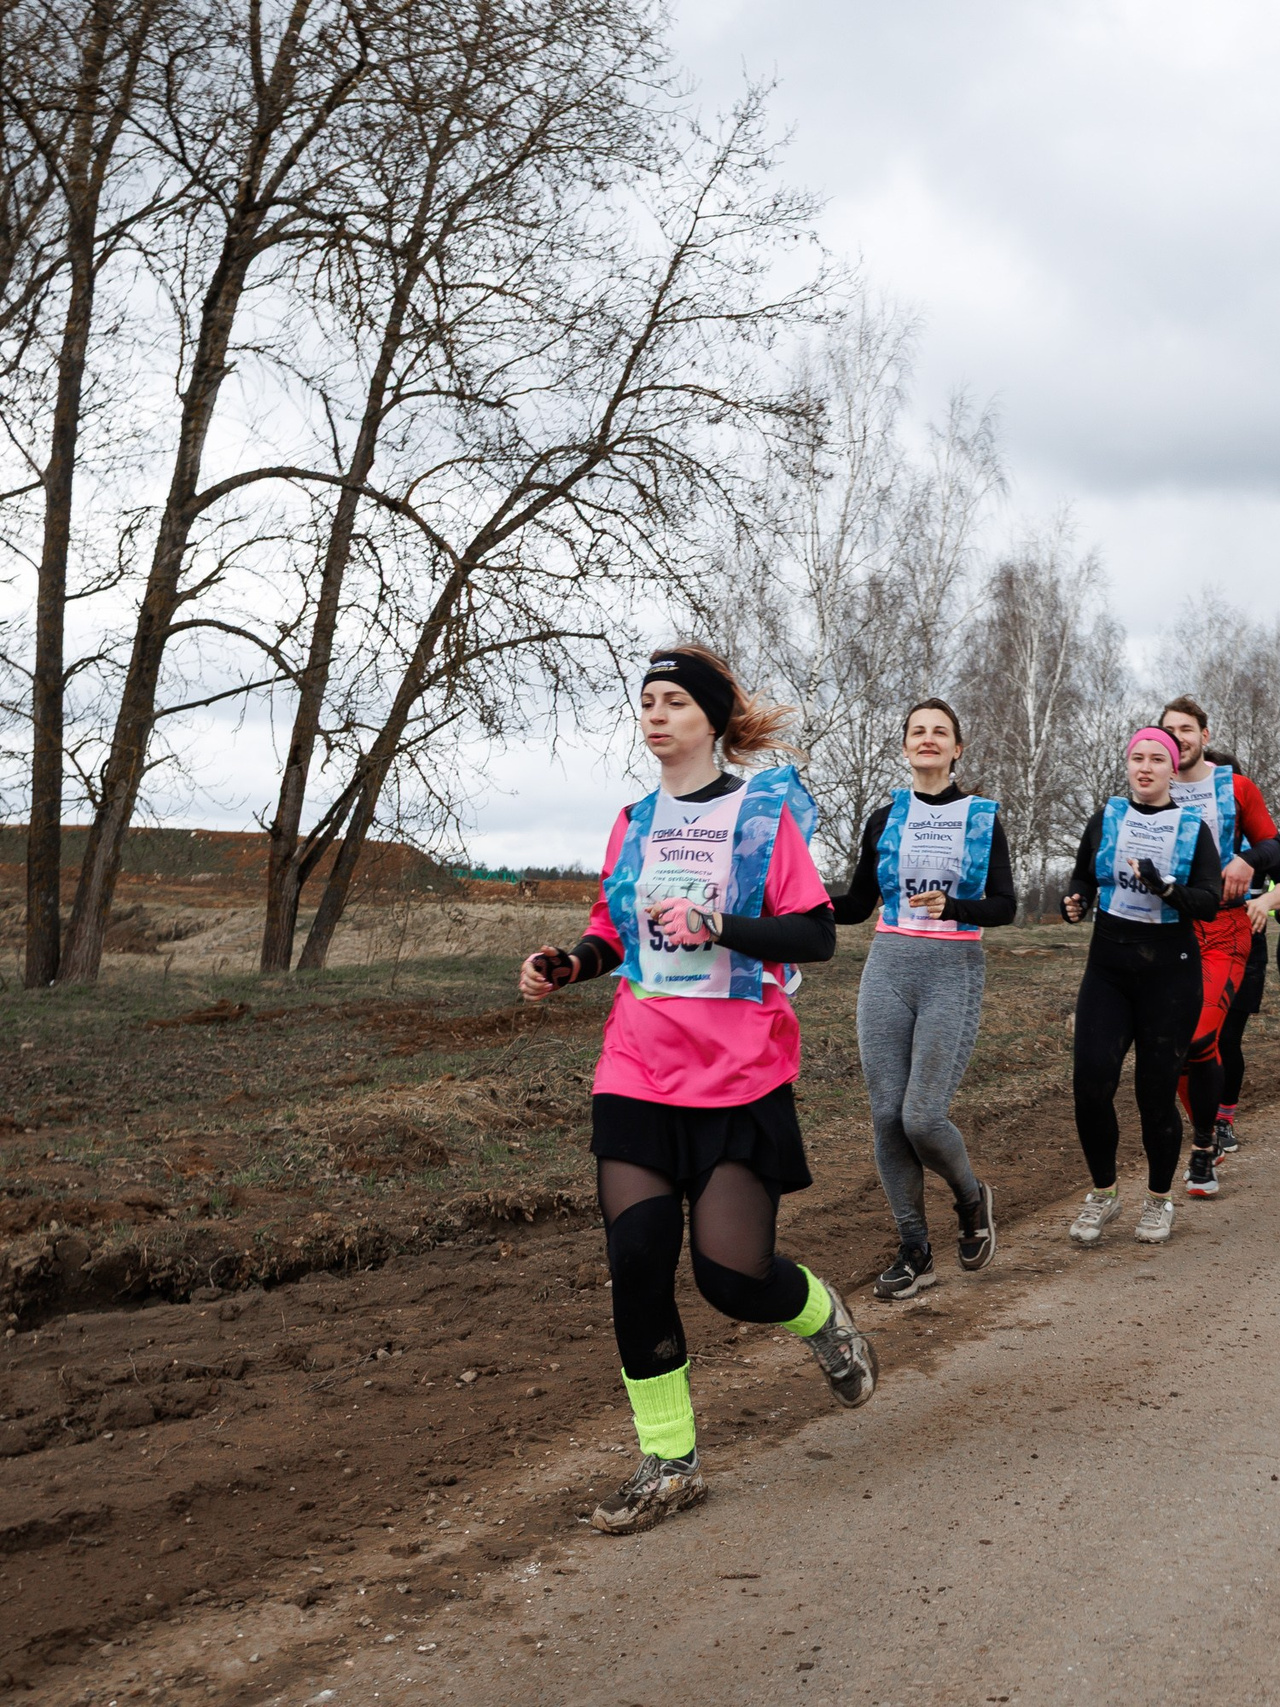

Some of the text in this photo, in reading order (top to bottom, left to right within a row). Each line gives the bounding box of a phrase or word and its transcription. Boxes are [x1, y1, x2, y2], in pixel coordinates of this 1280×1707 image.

[908, 820, 932, 828] ГОНКА
[652, 828, 729, 839] ГОНКА ГЕРОЕВ
[914, 831, 953, 841] Sminex
[660, 846, 715, 862] Sminex
